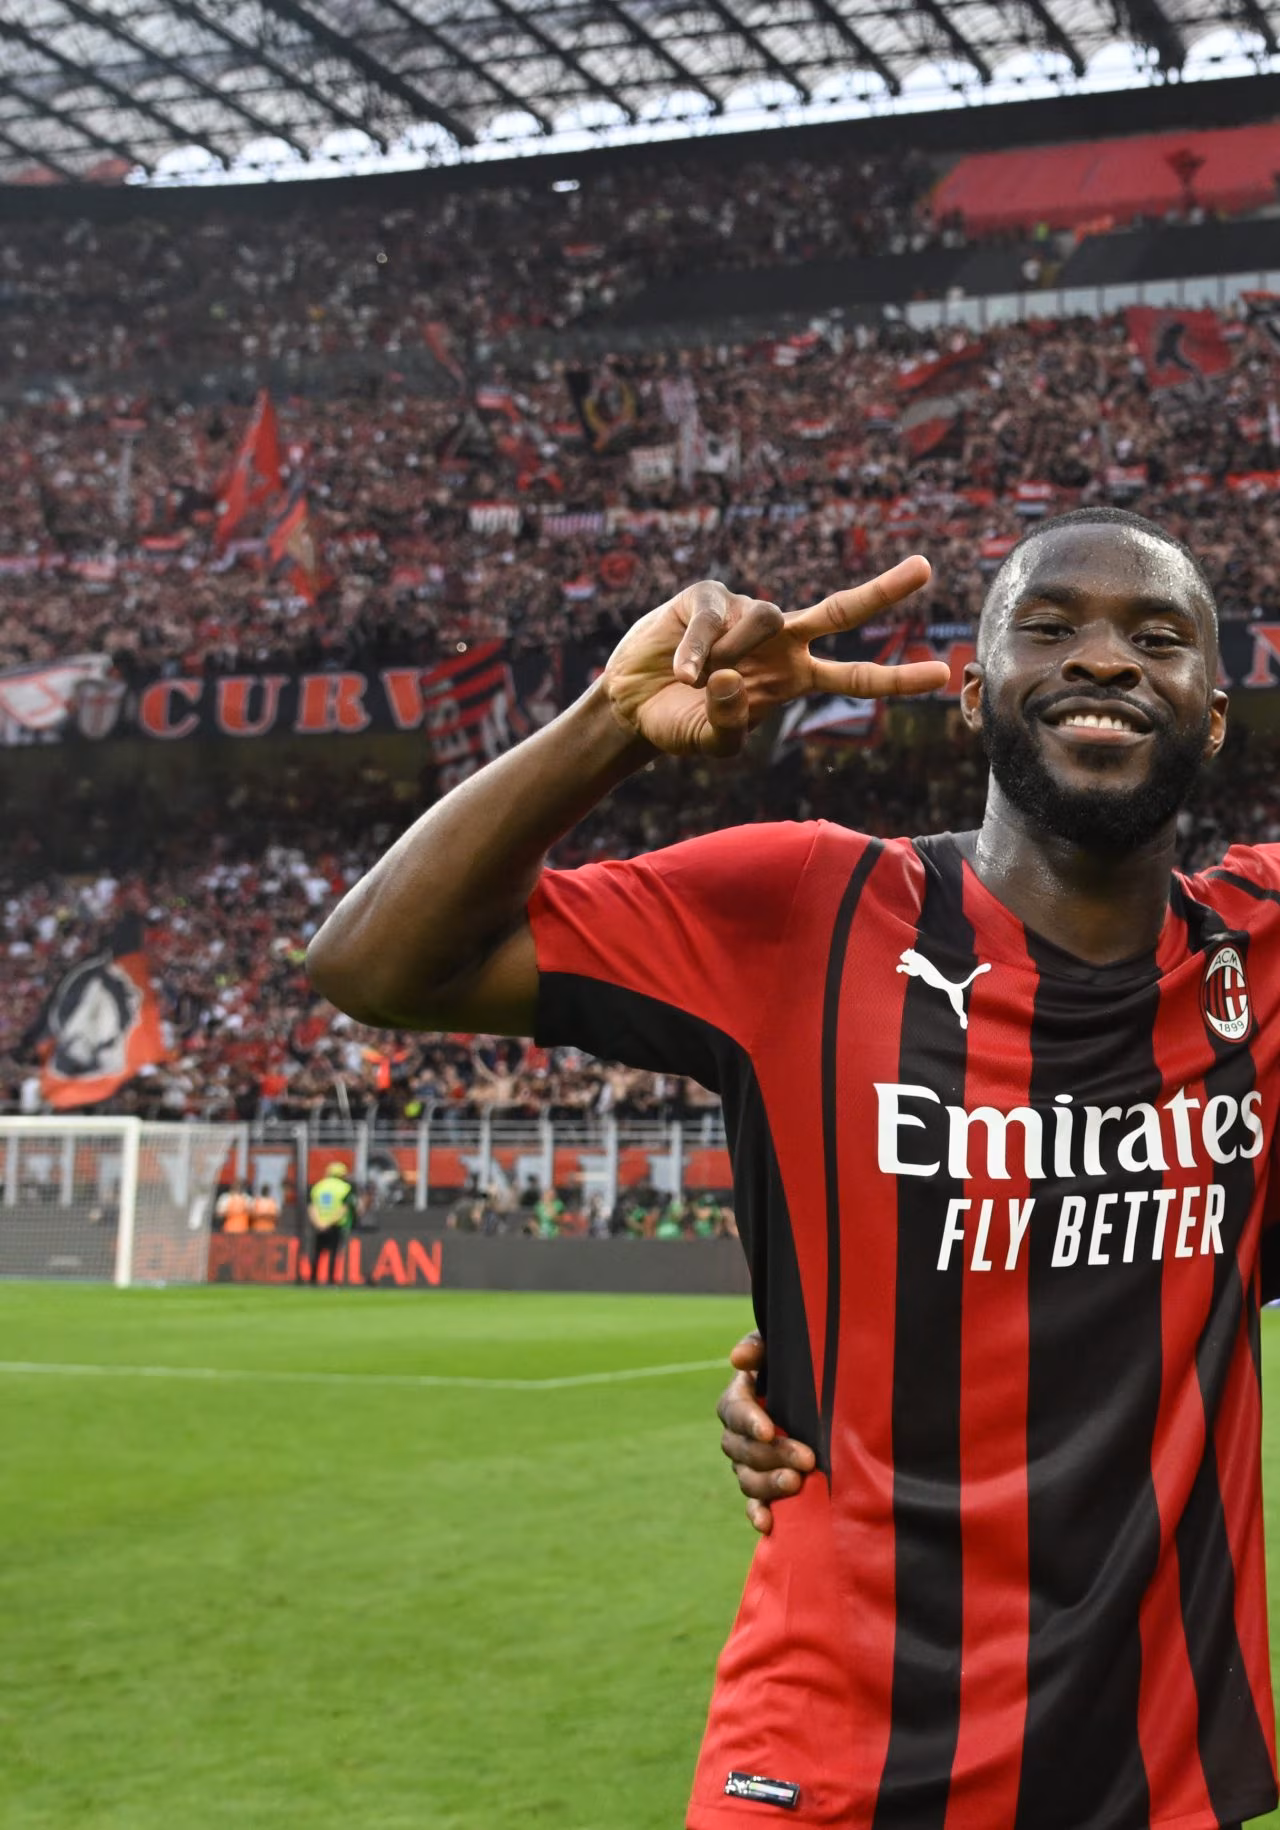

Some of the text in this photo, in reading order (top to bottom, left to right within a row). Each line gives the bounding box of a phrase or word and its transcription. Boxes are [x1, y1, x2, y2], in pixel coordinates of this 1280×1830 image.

[139, 666, 530, 739] CURV
[1213, 950, 1238, 970] ACM
[1219, 1020, 1245, 1033] 1899
[873, 1082, 1265, 1180] Emirates
[937, 1183, 1226, 1271] FLY BETTER
